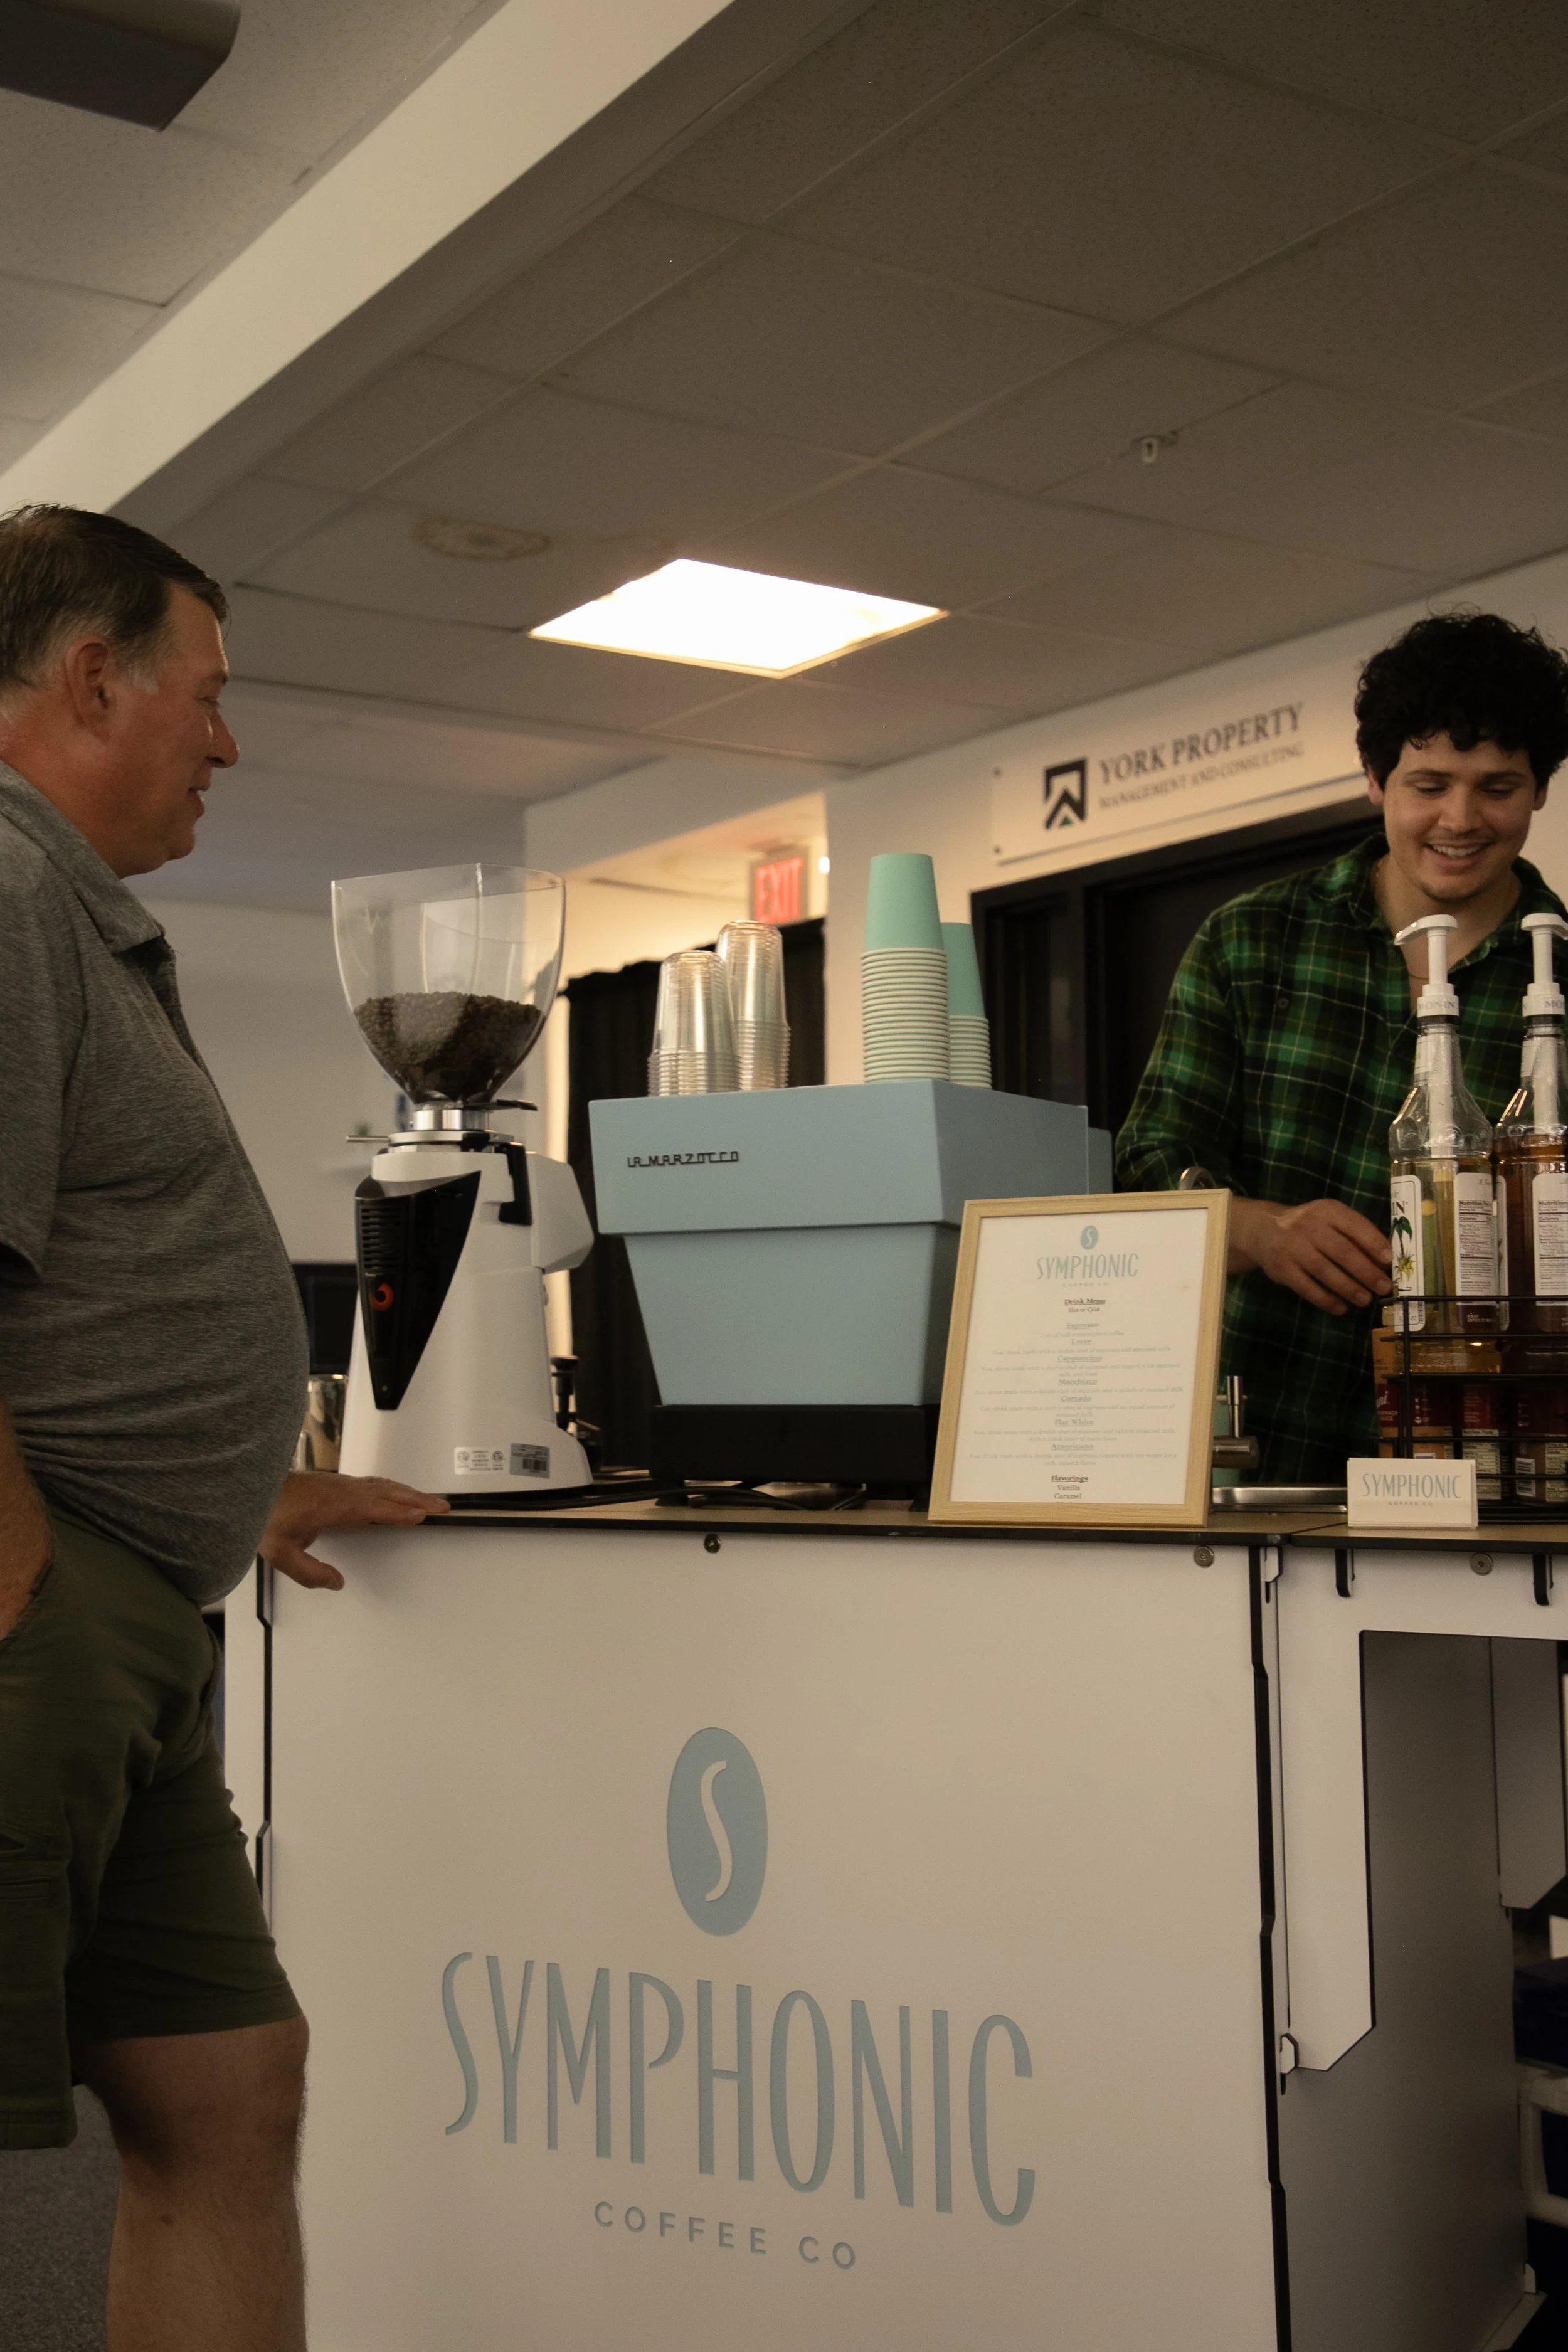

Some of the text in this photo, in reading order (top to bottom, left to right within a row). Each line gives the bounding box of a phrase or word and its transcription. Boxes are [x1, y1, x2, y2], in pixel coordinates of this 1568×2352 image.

[1099, 701, 1303, 784] YORK PROPERTY
[1099, 741, 1305, 810] MANAGEMENT AND CONSULTING
[755, 857, 803, 923] EXIT
[627, 1156, 642, 1168] LA
[1036, 1253, 1139, 1280] SYMPHONIC
[1051, 1475, 1089, 1483] Flavorings
[1362, 1473, 1461, 1499] SYMPHONIC
[442, 1952, 1036, 2227] SYMPHONIC
[595, 2201, 856, 2270] COFFEE CO
